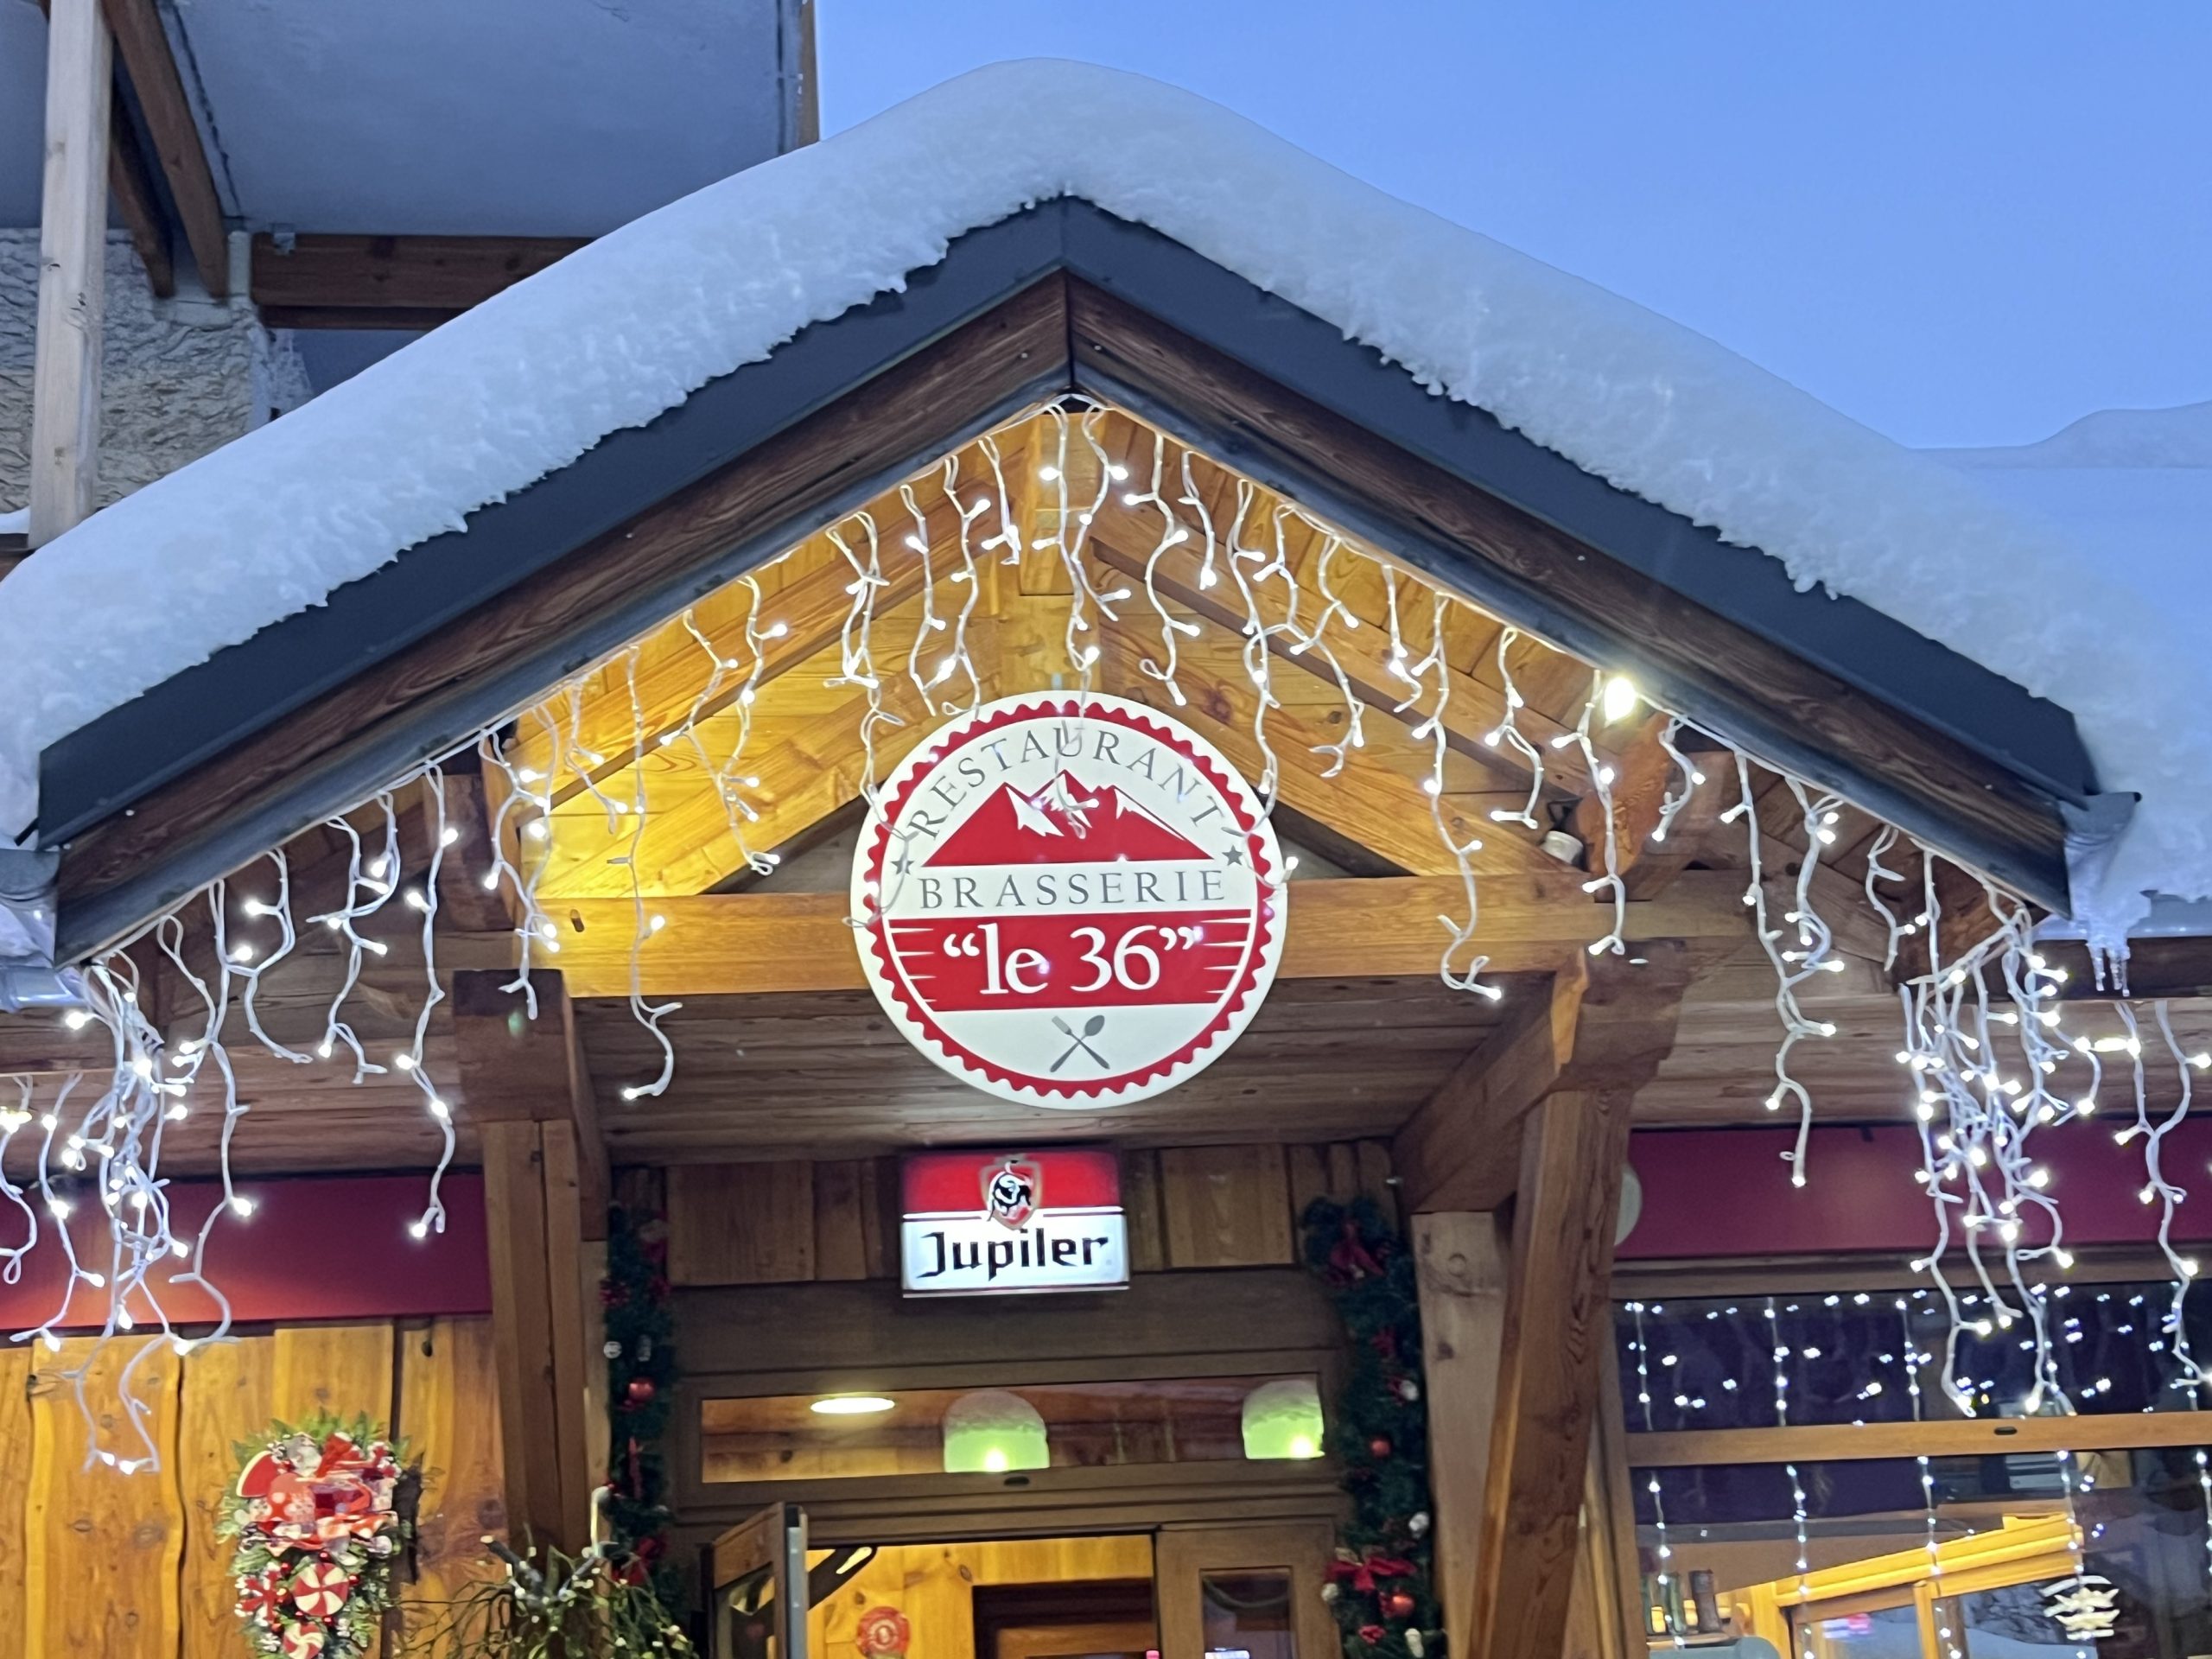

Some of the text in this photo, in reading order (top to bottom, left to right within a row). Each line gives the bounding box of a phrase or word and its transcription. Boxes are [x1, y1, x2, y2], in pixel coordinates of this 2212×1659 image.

[907, 727, 1225, 840] RESTAURANT
[919, 869, 1225, 909] BRASSERIE
[943, 922, 1196, 995] “le 36”
[916, 1227, 1109, 1281] Jupiler
